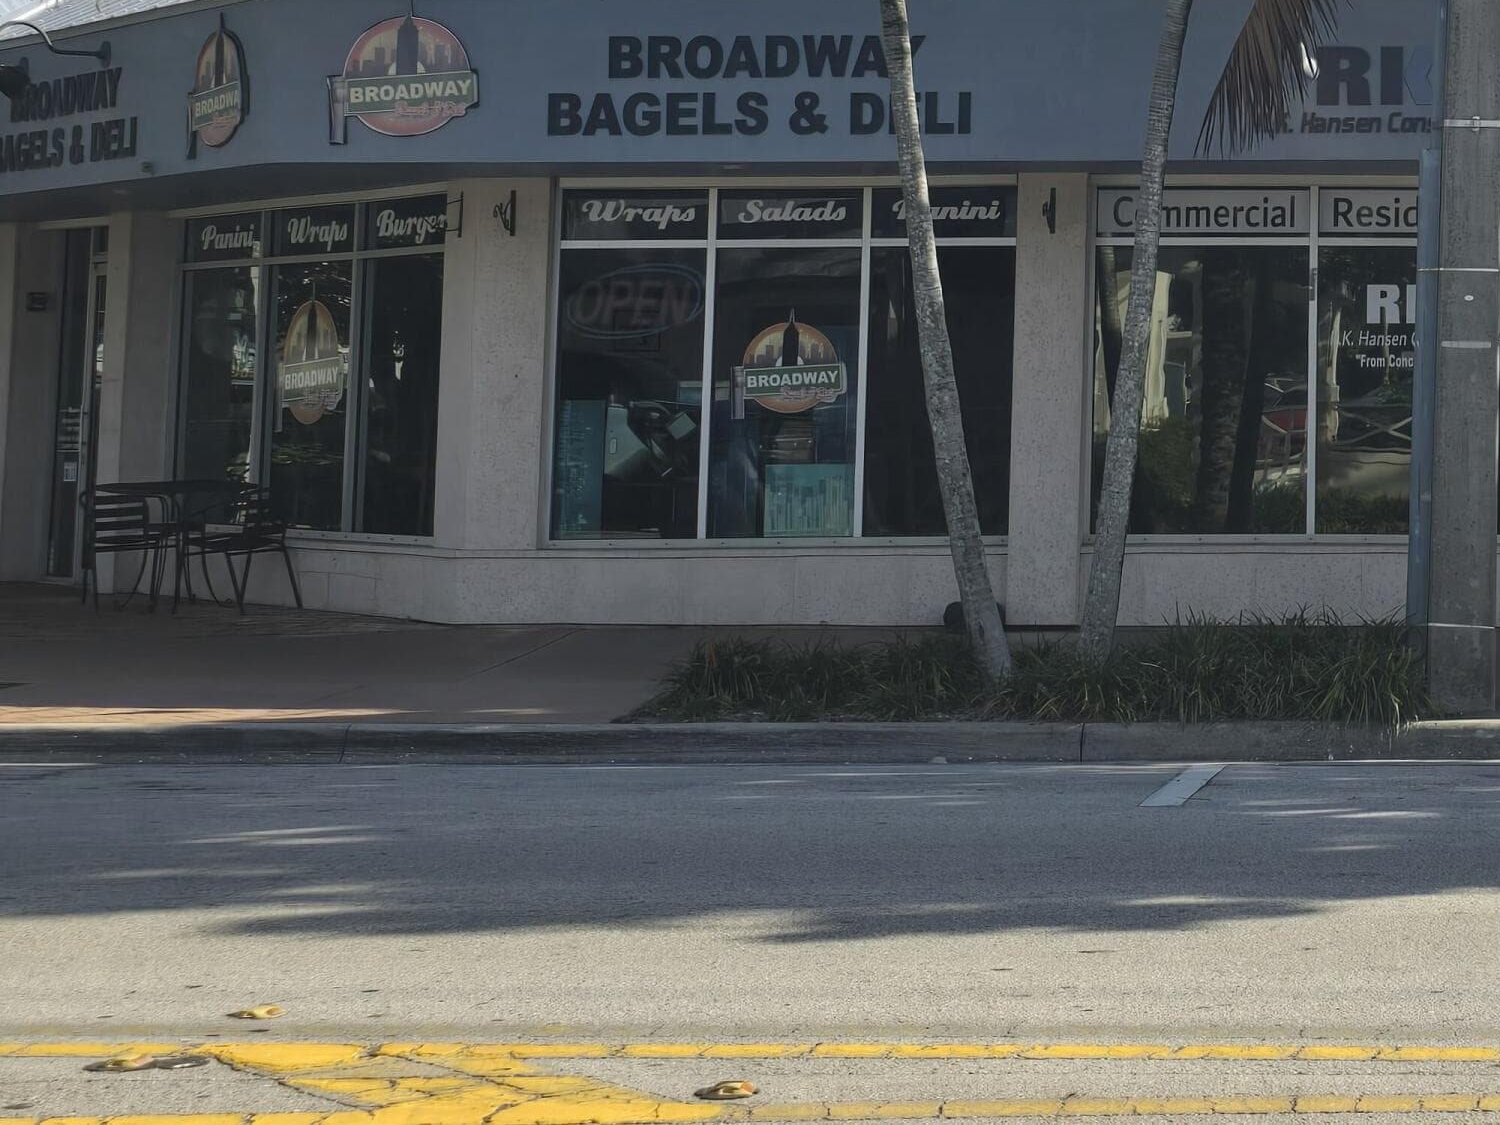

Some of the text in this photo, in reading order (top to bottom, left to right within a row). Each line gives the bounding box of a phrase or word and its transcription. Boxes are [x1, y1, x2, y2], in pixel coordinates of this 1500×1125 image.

[350, 79, 472, 103] BROADWAY
[547, 92, 770, 136] BAGELS
[790, 91, 830, 135] &
[0, 128, 65, 173] AGELS
[583, 199, 696, 230] Wraps
[738, 200, 847, 223] Salads
[1113, 195, 1296, 229] Cmmercial
[202, 224, 255, 251] Panini
[288, 215, 349, 252] Wraps
[576, 280, 692, 327] OPEN
[1359, 330, 1407, 346] Hansen
[285, 367, 339, 391] BROADWAY
[747, 371, 838, 387] BROADWAY
